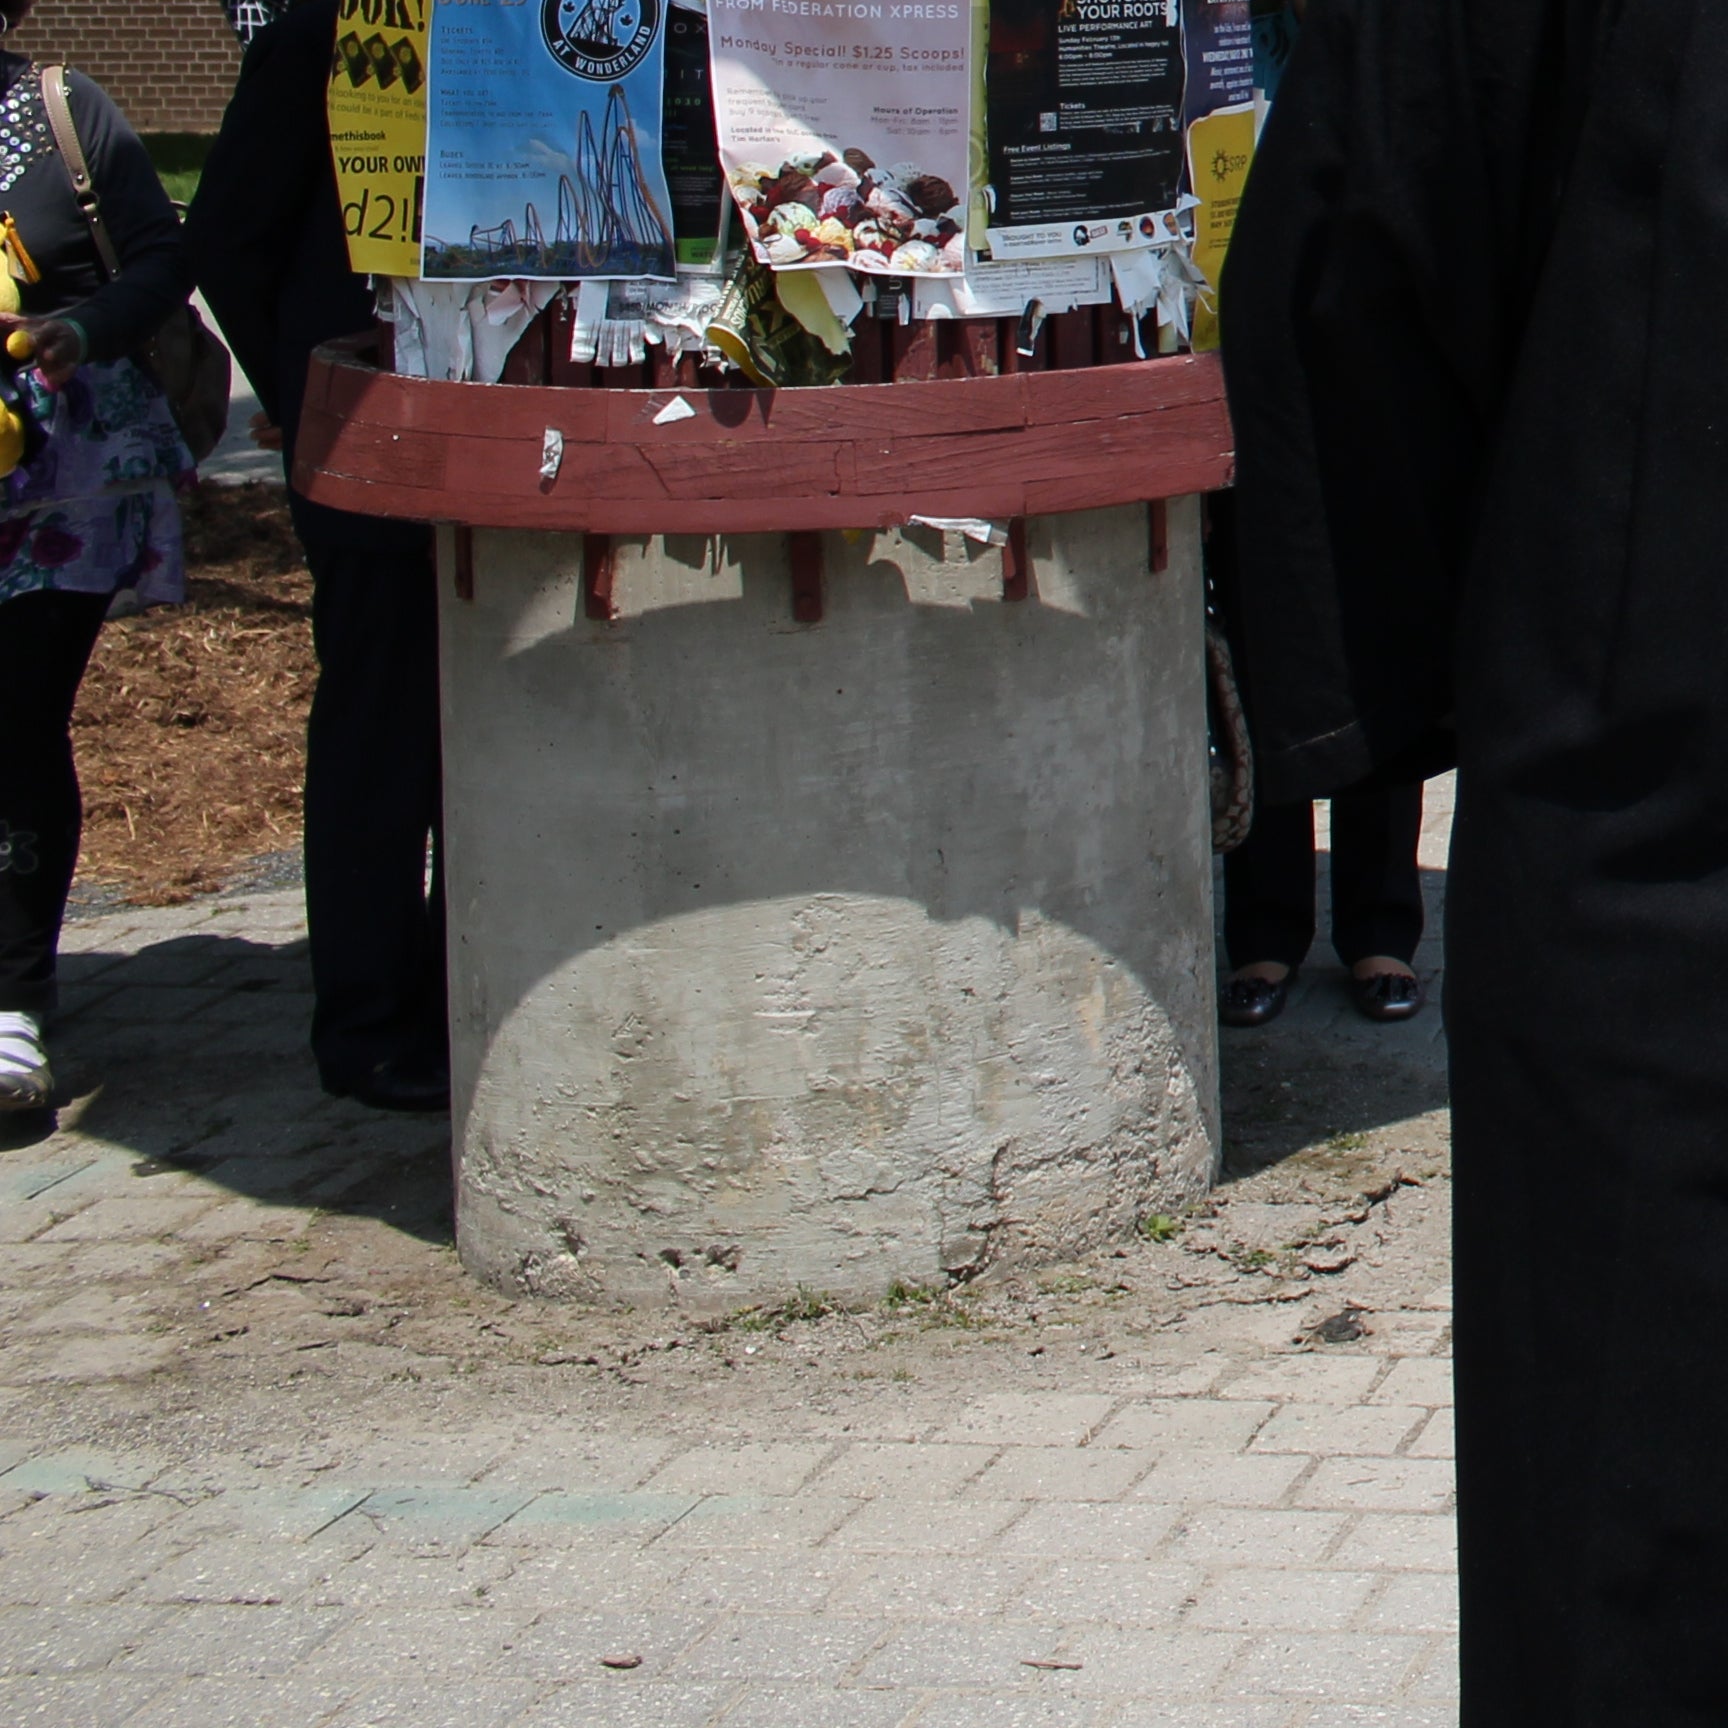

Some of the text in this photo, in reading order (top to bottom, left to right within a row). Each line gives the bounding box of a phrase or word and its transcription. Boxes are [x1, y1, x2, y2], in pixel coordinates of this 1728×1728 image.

[772, 0, 882, 19] FEDERATION
[890, 4, 959, 19] XPRESS
[1077, 5, 1120, 19] YOUR
[552, 26, 651, 74] AT WONDERLAND
[721, 35, 965, 61] Monday Special! $1.25 Scoops!
